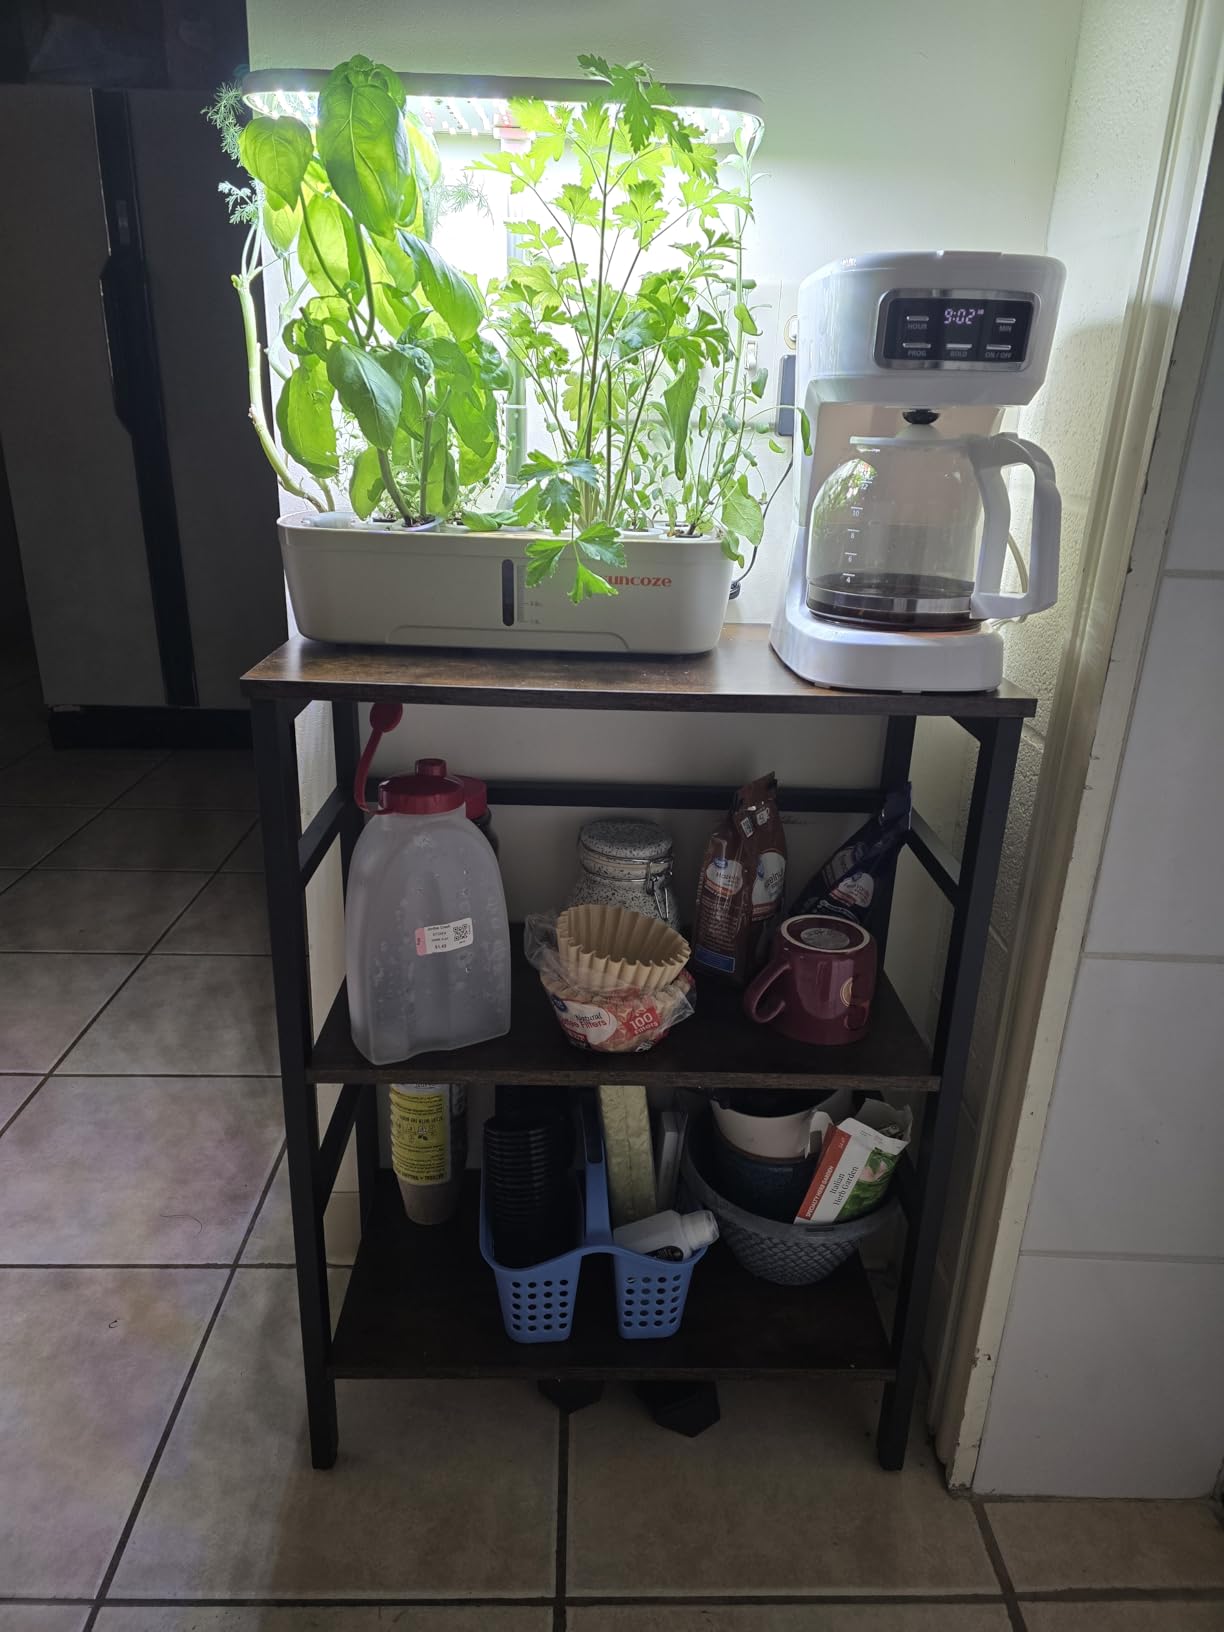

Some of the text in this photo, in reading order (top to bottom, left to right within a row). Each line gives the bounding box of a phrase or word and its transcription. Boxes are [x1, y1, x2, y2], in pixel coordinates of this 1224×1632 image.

[944, 308, 976, 325] 9:02
[907, 322, 928, 330] HOUR
[999, 325, 1012, 333] MIN
[603, 575, 672, 587] uncoze
[579, 1020, 607, 1029] Filters
[629, 1012, 653, 1030] 100
[829, 1173, 845, 1194] Italian
[833, 1166, 859, 1206] Herb Garden
